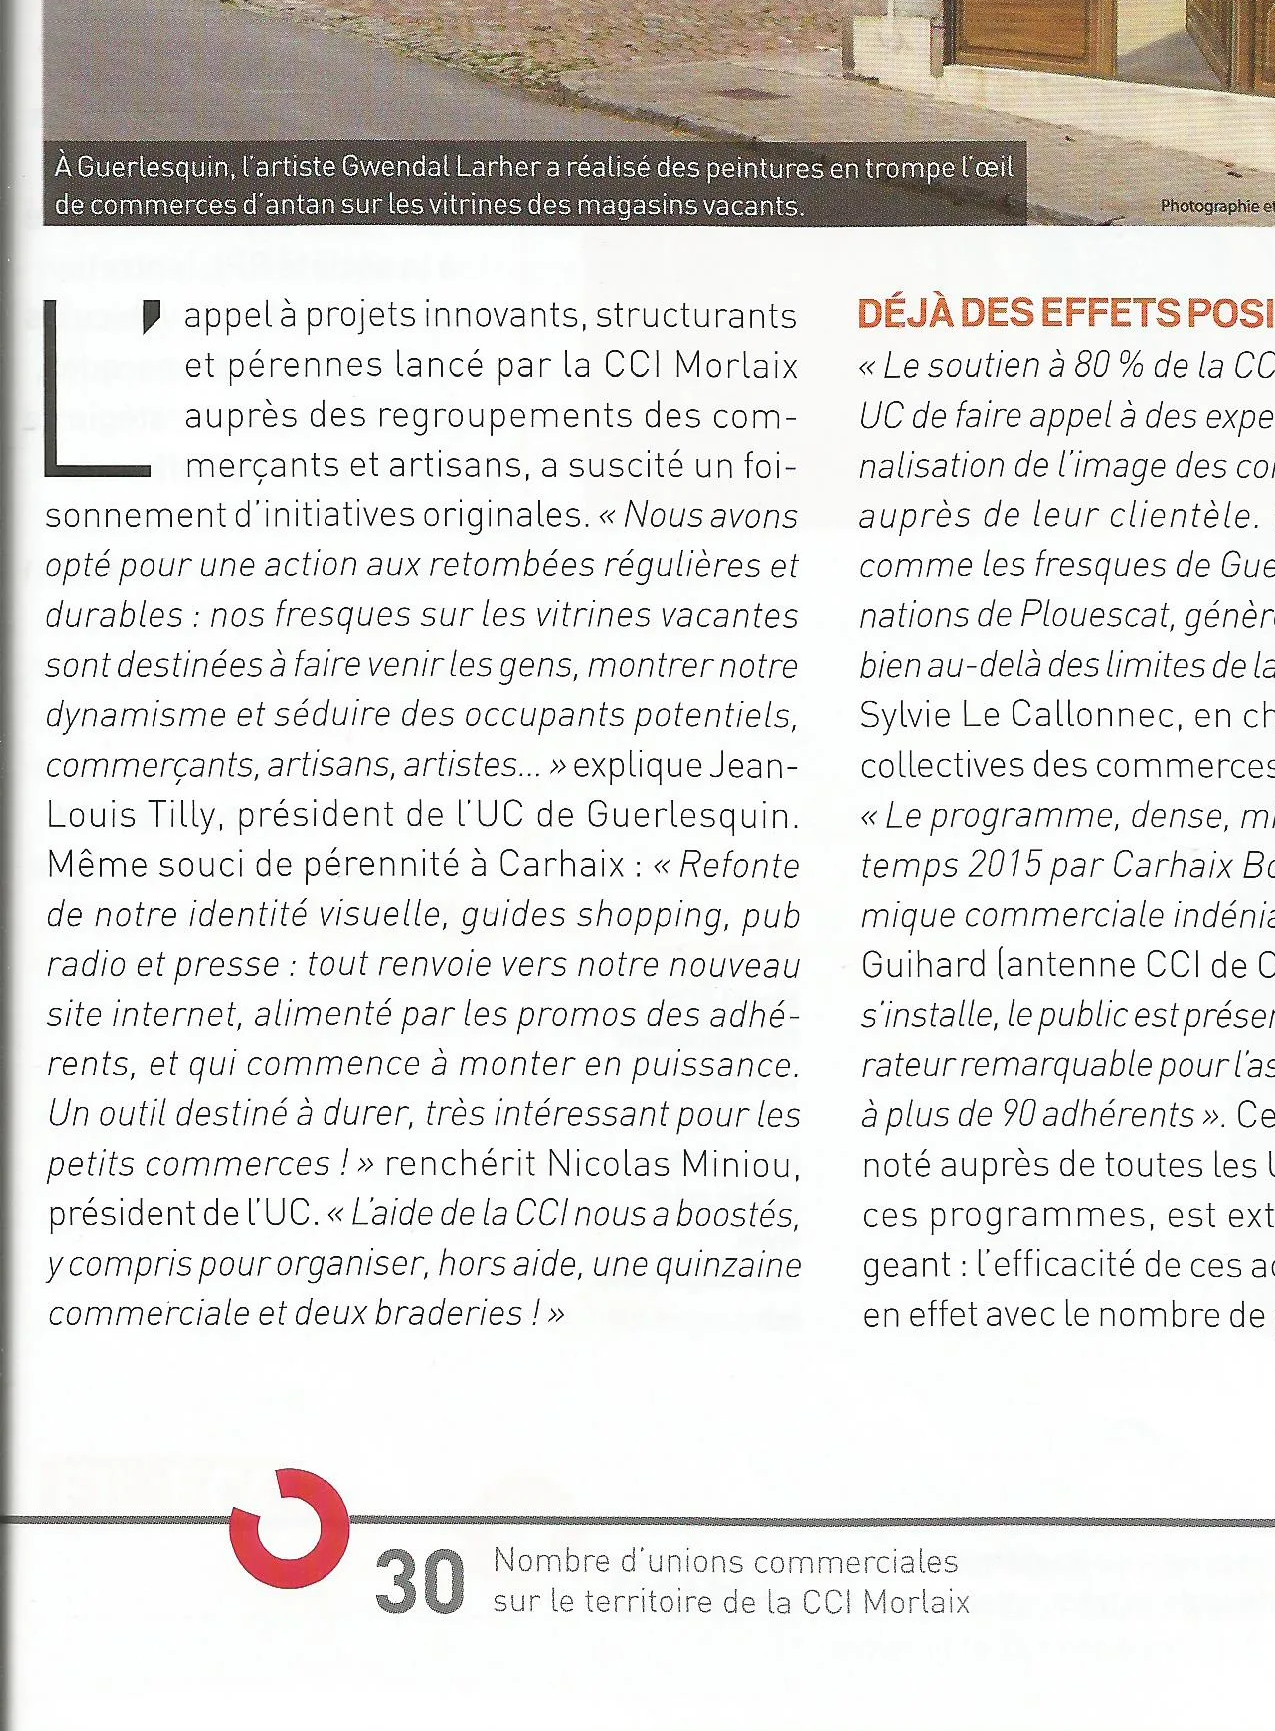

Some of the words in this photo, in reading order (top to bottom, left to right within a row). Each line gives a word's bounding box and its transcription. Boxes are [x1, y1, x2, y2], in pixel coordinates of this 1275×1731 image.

[54, 148, 74, 178] À
[77, 155, 237, 185] Guerlesquin,
[242, 154, 337, 178] l'artiste
[342, 153, 451, 178] Gwendal
[457, 153, 542, 178] Larher
[545, 160, 560, 178] a
[567, 154, 651, 179] réalisé
[657, 155, 700, 179] des
[706, 156, 825, 185] peintures
[830, 162, 859, 179] en
[864, 158, 956, 185] trompe
[962, 154, 1015, 178] l'œil
[55, 192, 85, 215] de
[90, 198, 237, 216] commerces
[243, 192, 335, 216] d'antan
[340, 197, 383, 214] sur
[389, 191, 425, 215] les
[428, 191, 522, 216] vitrines
[527, 191, 572, 216] des
[577, 192, 698, 221] magasins
[702, 196, 805, 217] vacants.
[184, 298, 273, 336] appel
[280, 297, 296, 328] à
[307, 298, 416, 336] projets
[425, 298, 587, 333] innovants,
[596, 302, 797, 329] structurants
[857, 290, 957, 329] DÉJÀ
[961, 296, 1035, 328] DES
[1041, 296, 1181, 329] EFFETS
[861, 749, 1025, 779] collectives
[1033, 748, 1088, 778] des
[495, 1546, 610, 1573] Nombre
[621, 1546, 744, 1574] d'unions
[754, 1547, 959, 1574] commerciales
[375, 1548, 465, 1615] 30
[493, 1594, 541, 1613] sur
[551, 1586, 574, 1613] le
[584, 1586, 712, 1614] territoire
[723, 1588, 756, 1614] de
[768, 1588, 791, 1615] la
[803, 1588, 851, 1615] CCI
[864, 1587, 971, 1614] Morlaix
